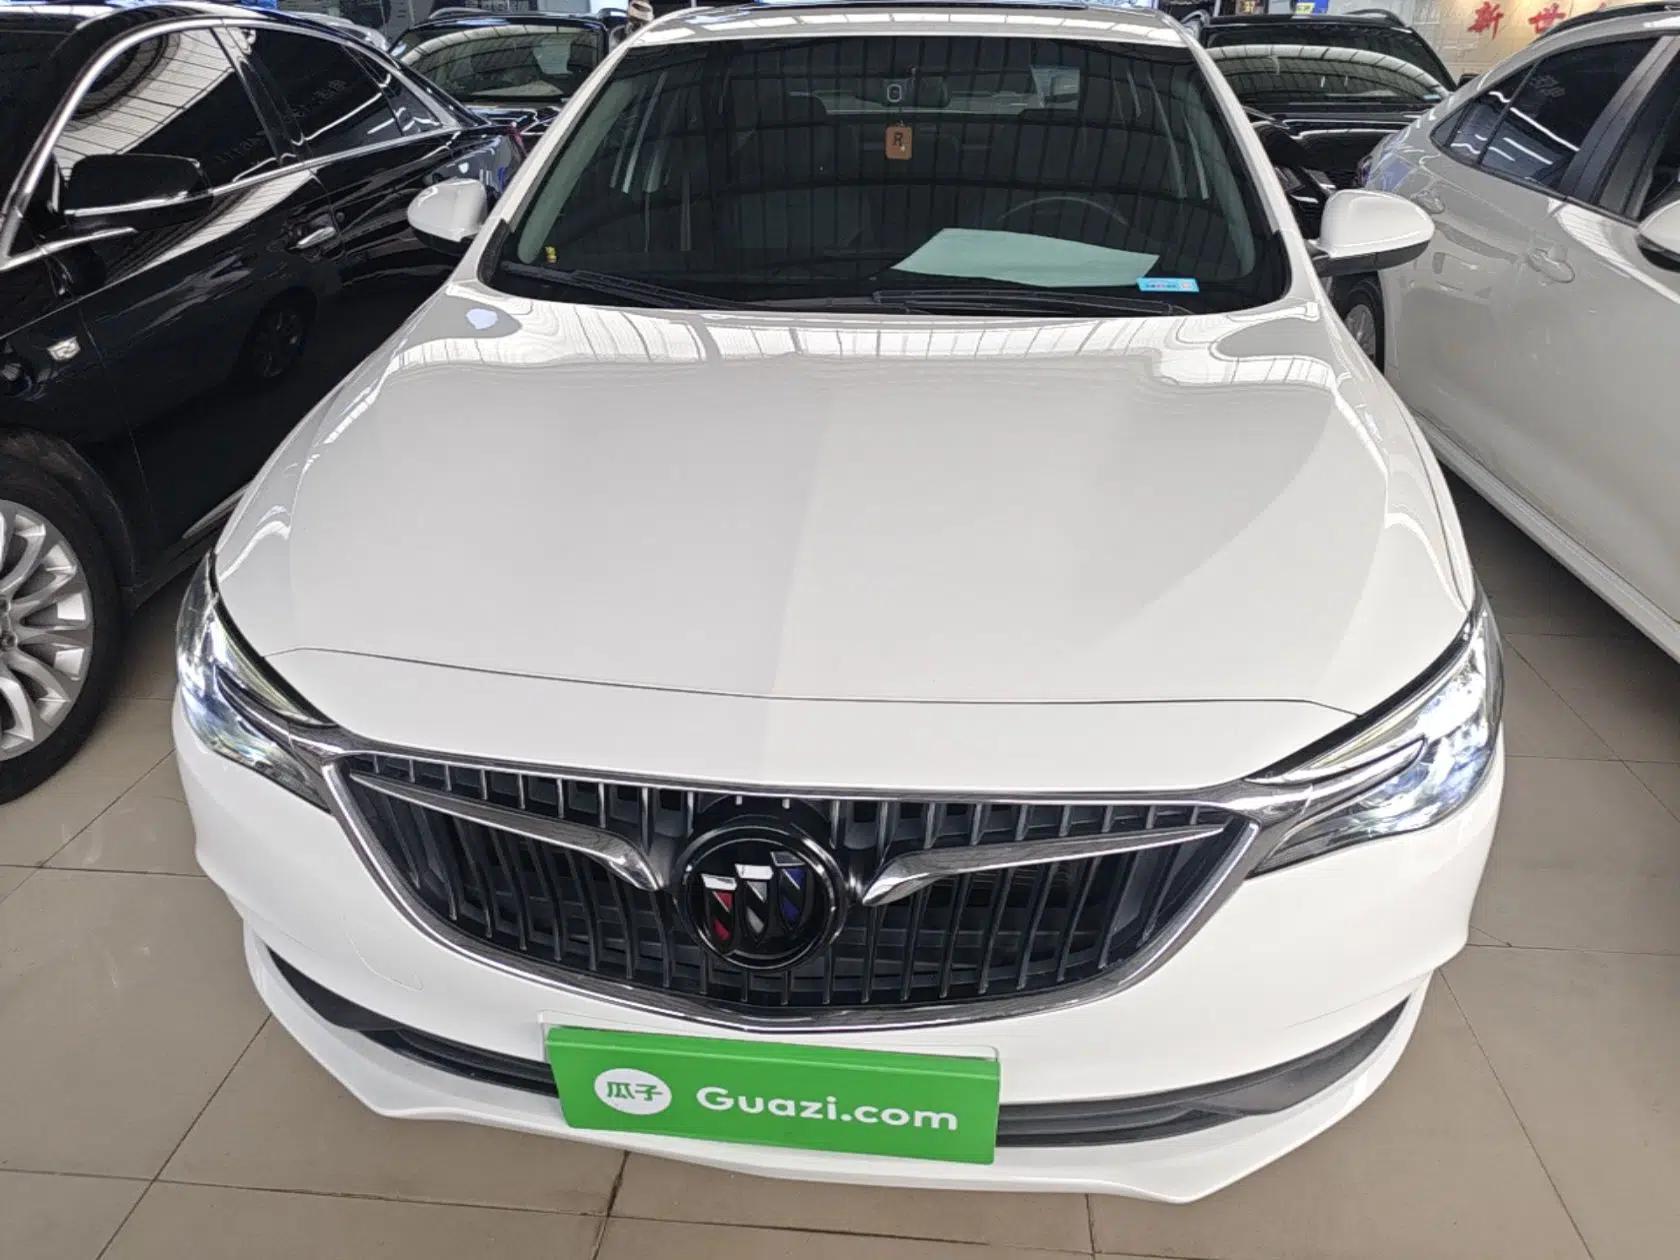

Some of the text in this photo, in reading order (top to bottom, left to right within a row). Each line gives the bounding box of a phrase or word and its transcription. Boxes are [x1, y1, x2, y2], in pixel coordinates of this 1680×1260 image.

[1467, 1, 1607, 39] 新世
[606, 1081, 663, 1101] 瓜子
[696, 1086, 957, 1131] Guazi.com
